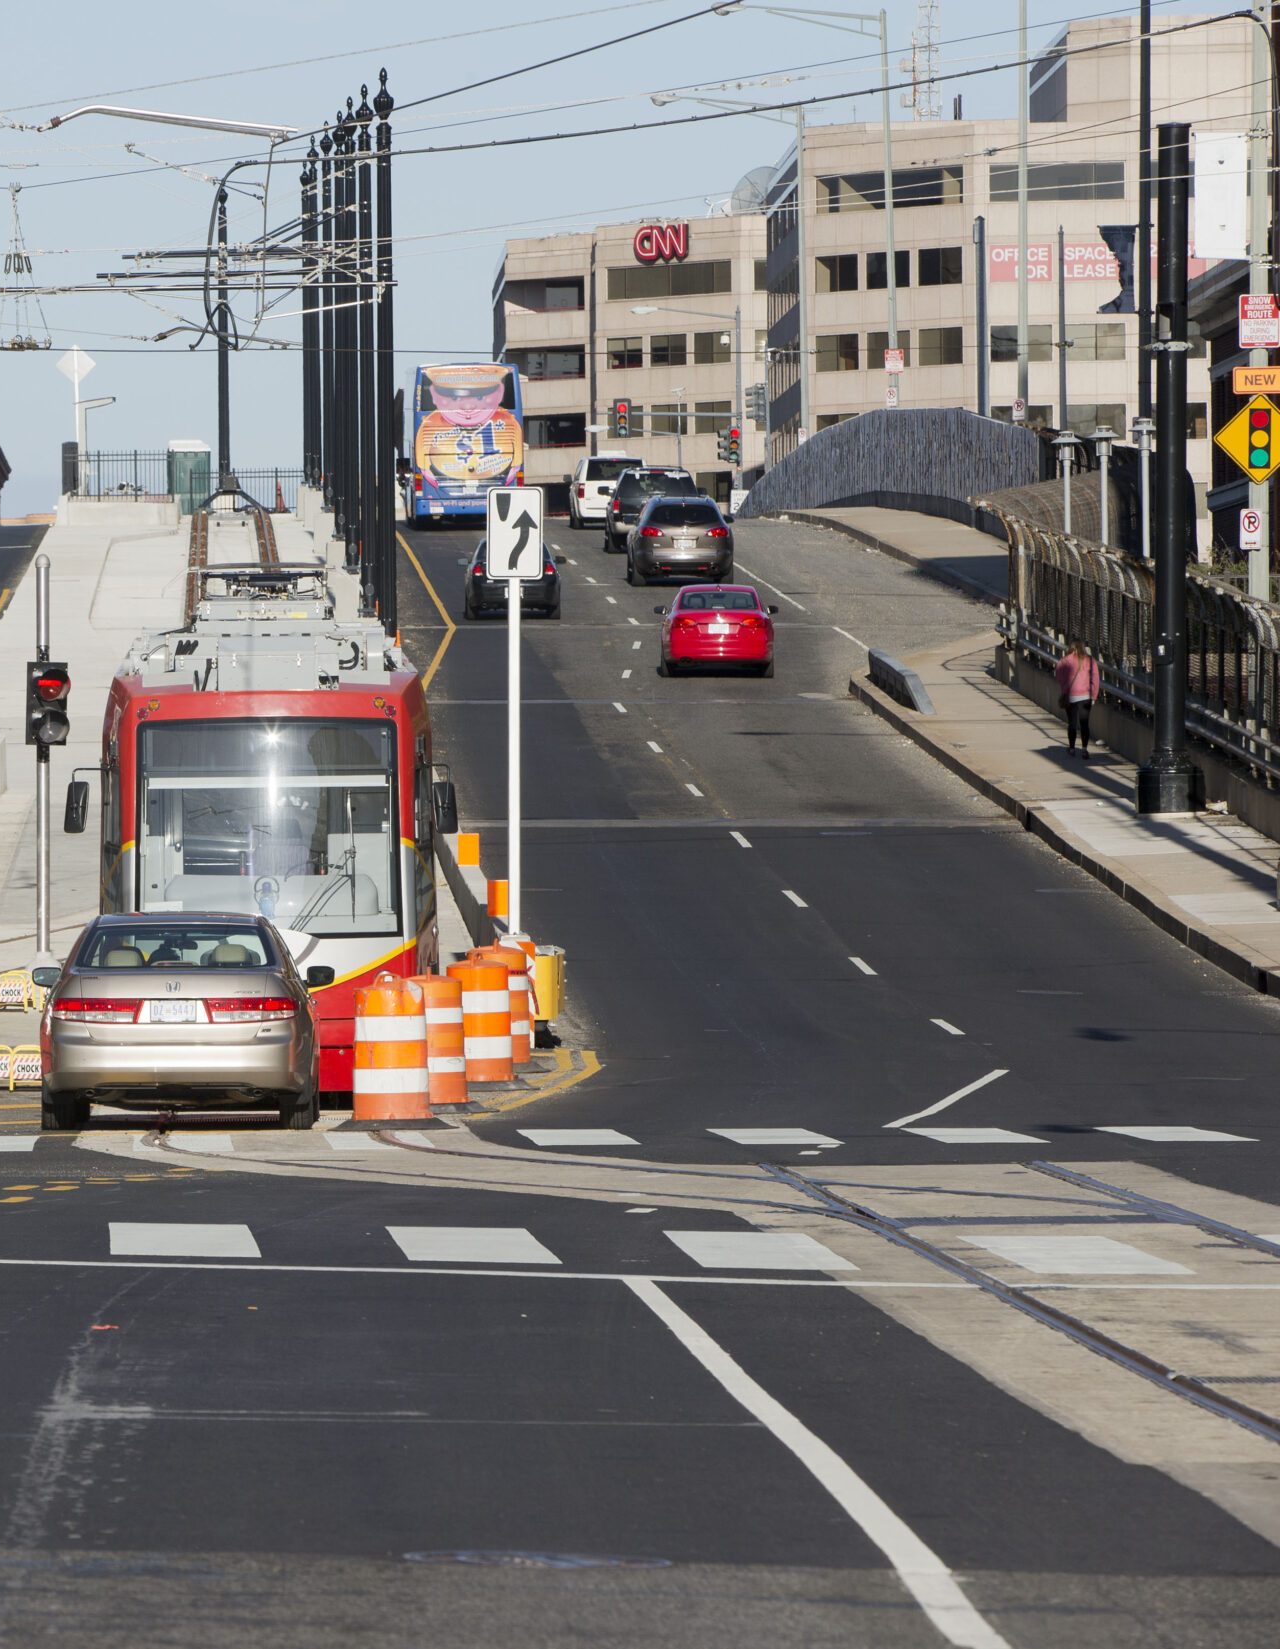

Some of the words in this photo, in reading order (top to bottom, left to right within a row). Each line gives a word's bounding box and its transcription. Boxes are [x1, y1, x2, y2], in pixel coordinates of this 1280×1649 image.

[634, 224, 688, 264] CNN
[991, 247, 1049, 262] OFFCE
[1064, 264, 1117, 278] LEASE
[1248, 296, 1271, 305] SNOW
[1247, 310, 1273, 319] ROUTE
[1244, 374, 1276, 386] NEW
[16, 1064, 40, 1073] CHOCK
